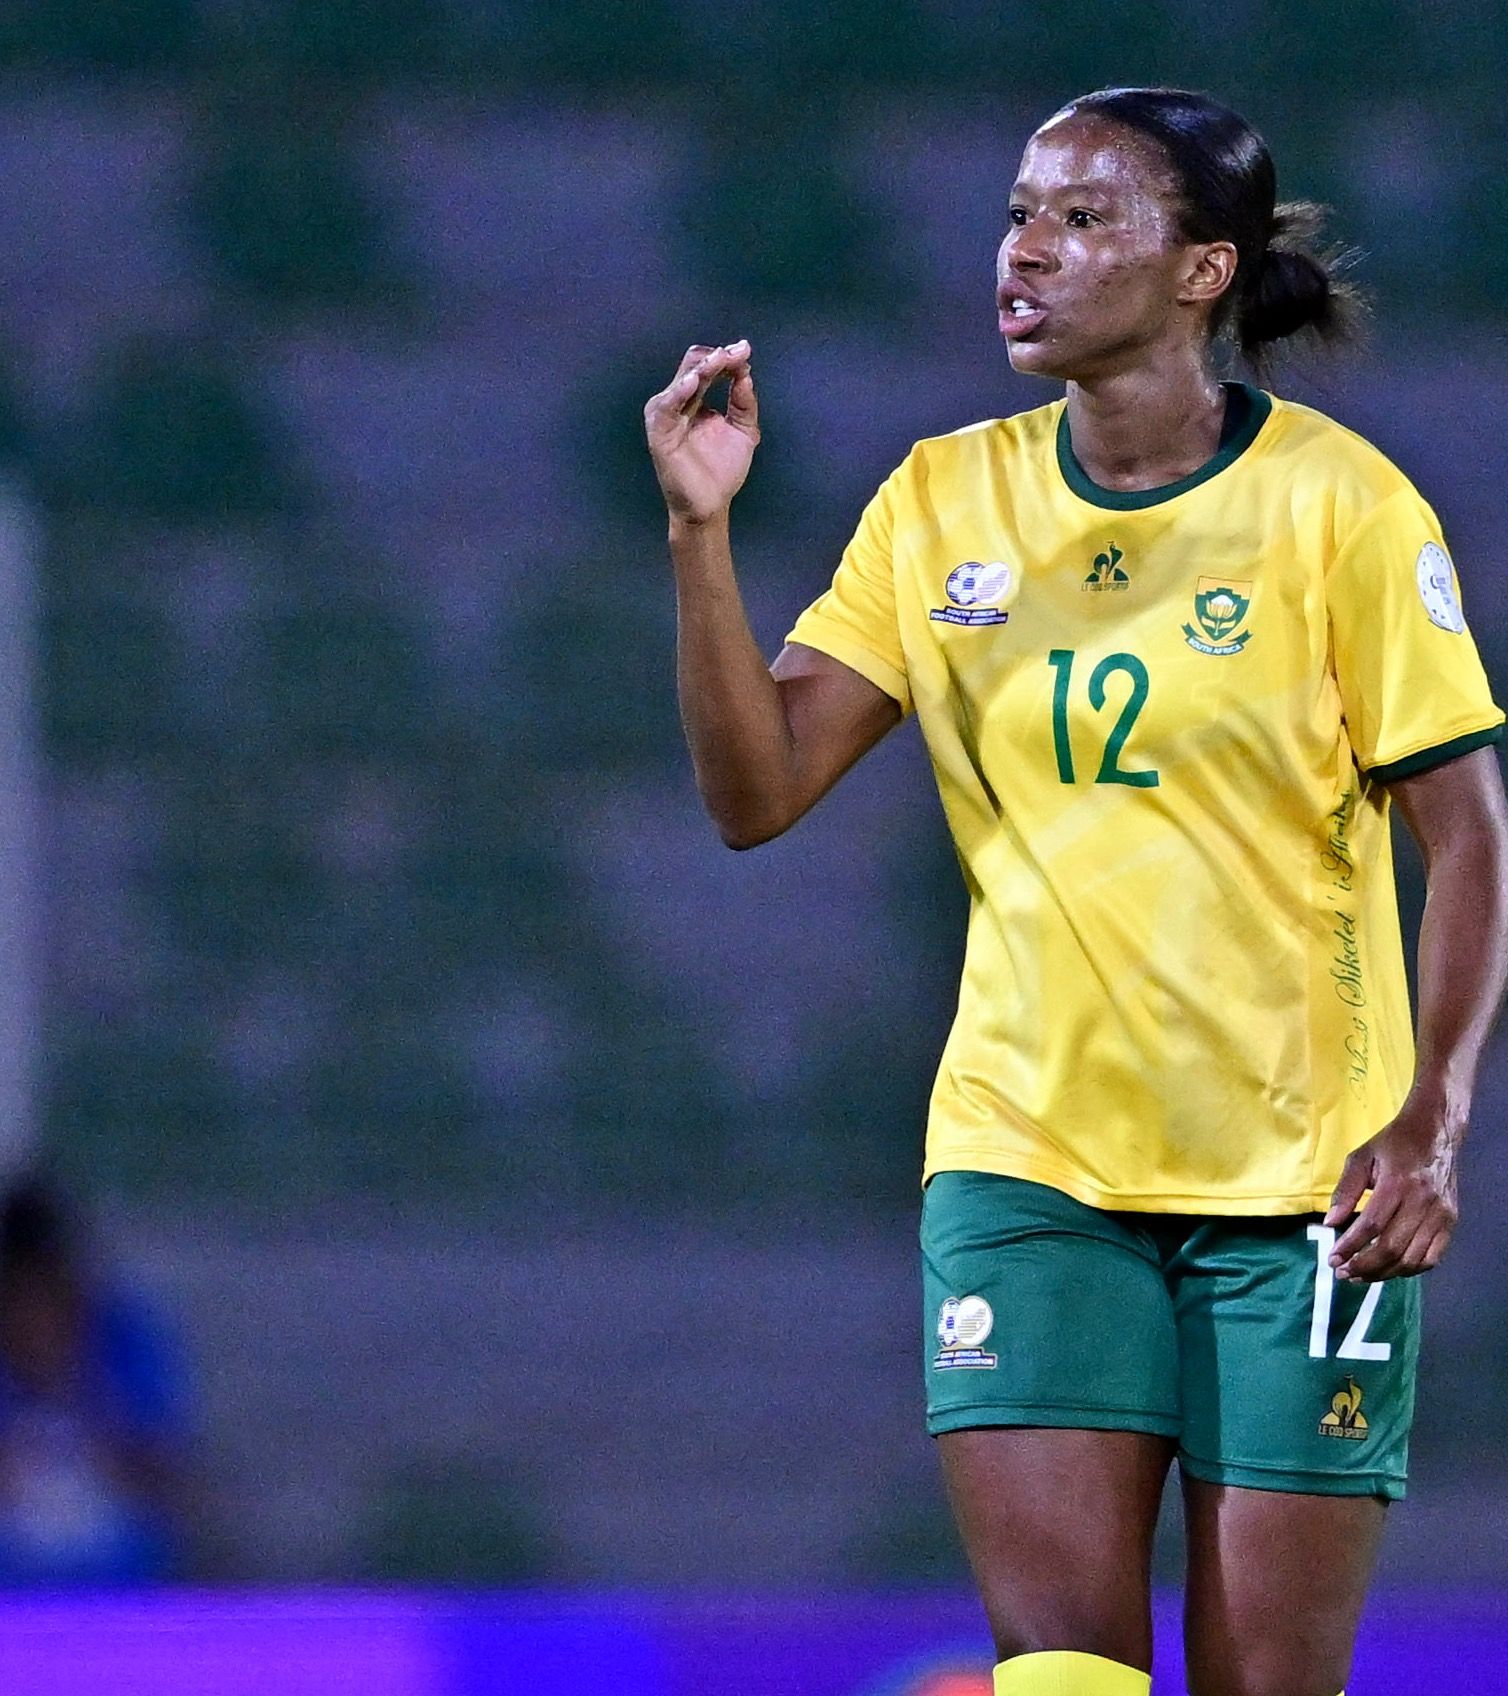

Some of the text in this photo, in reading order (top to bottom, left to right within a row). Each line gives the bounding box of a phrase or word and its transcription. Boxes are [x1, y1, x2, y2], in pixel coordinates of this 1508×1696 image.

[930, 612, 967, 625] FOOTBALL
[1048, 649, 1160, 788] 12
[1318, 1424, 1329, 1436] LE
